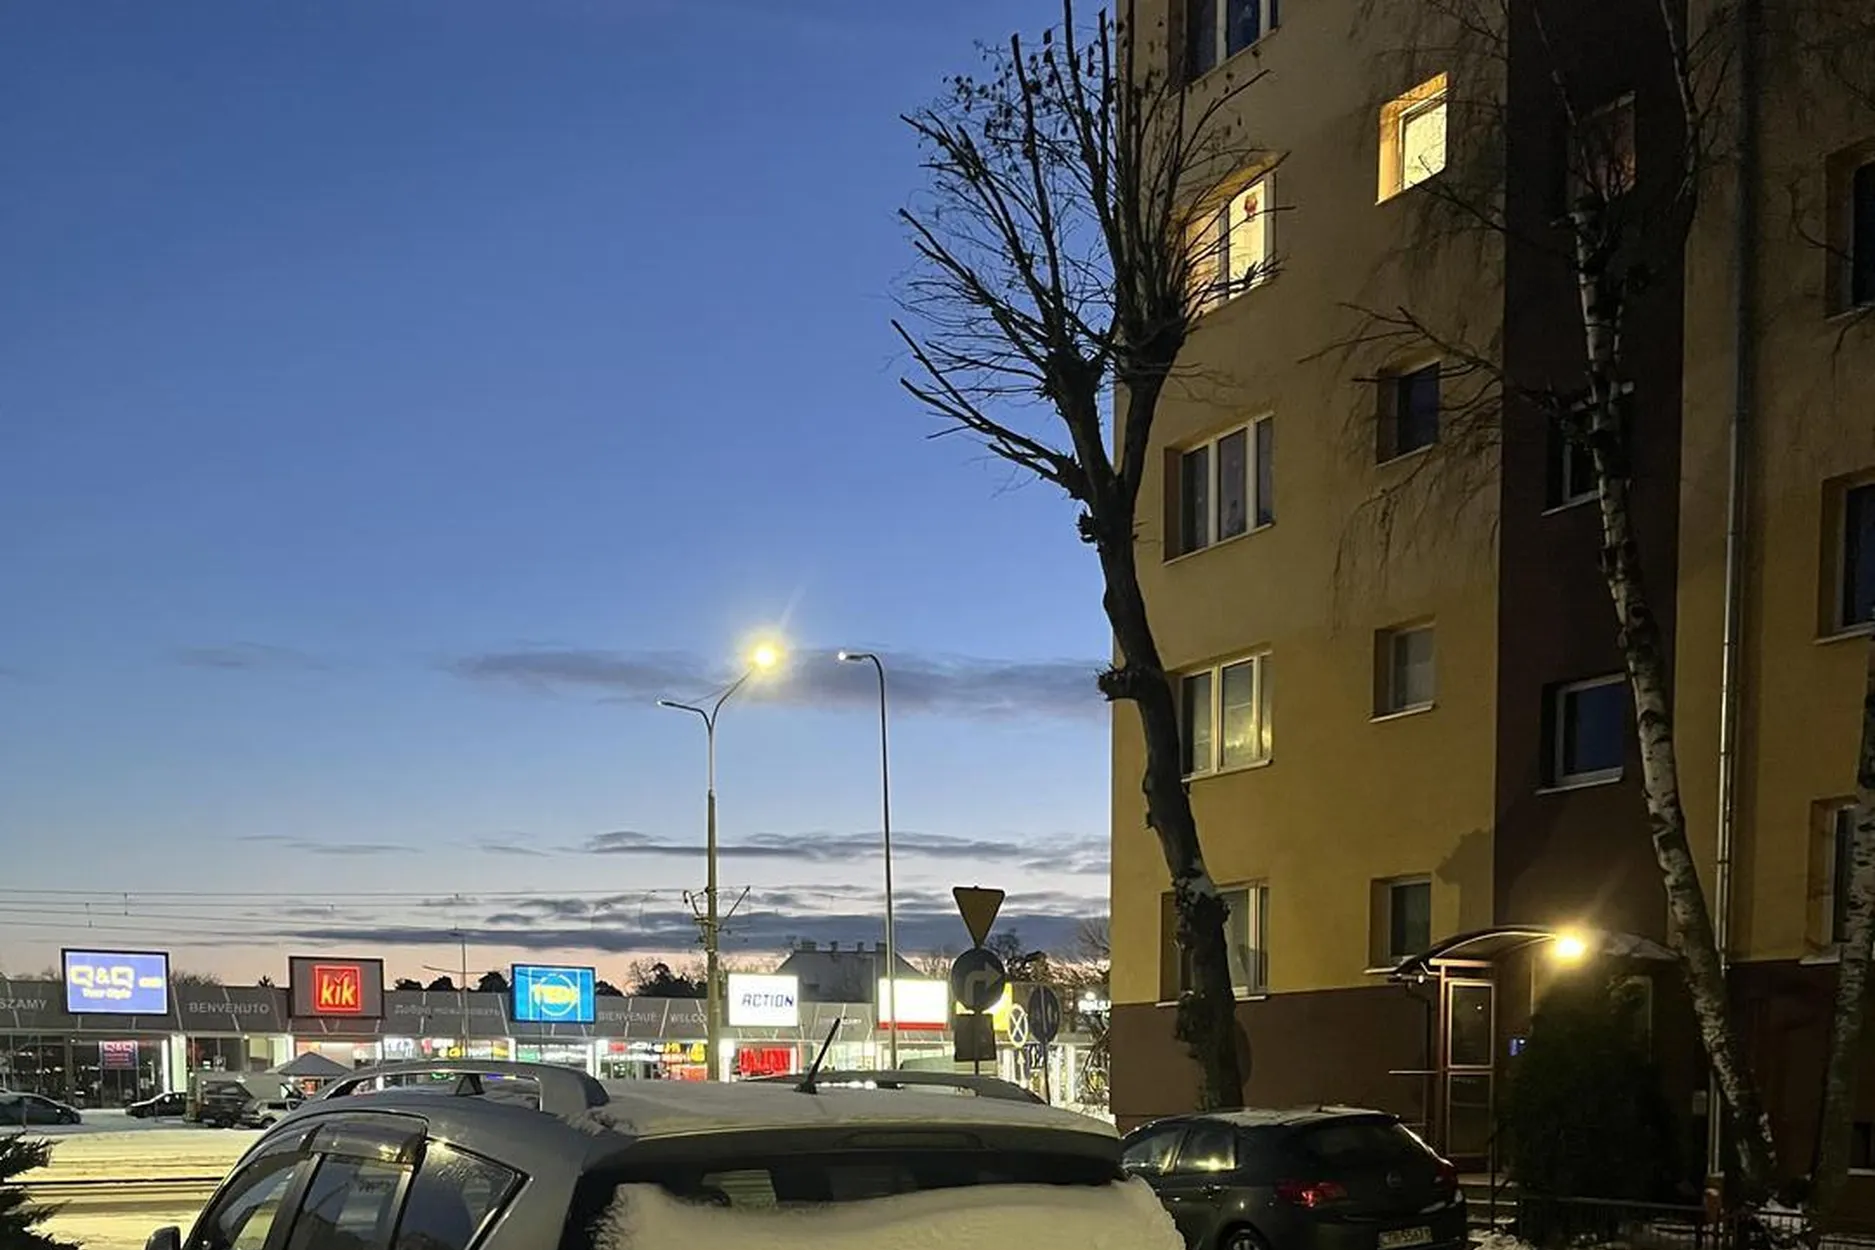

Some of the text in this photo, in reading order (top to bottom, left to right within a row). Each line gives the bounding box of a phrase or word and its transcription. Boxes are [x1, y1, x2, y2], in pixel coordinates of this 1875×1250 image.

[70, 965, 134, 988] Q&Q
[742, 993, 795, 1007] ACTION
[188, 1001, 271, 1015] BENVENUTO
